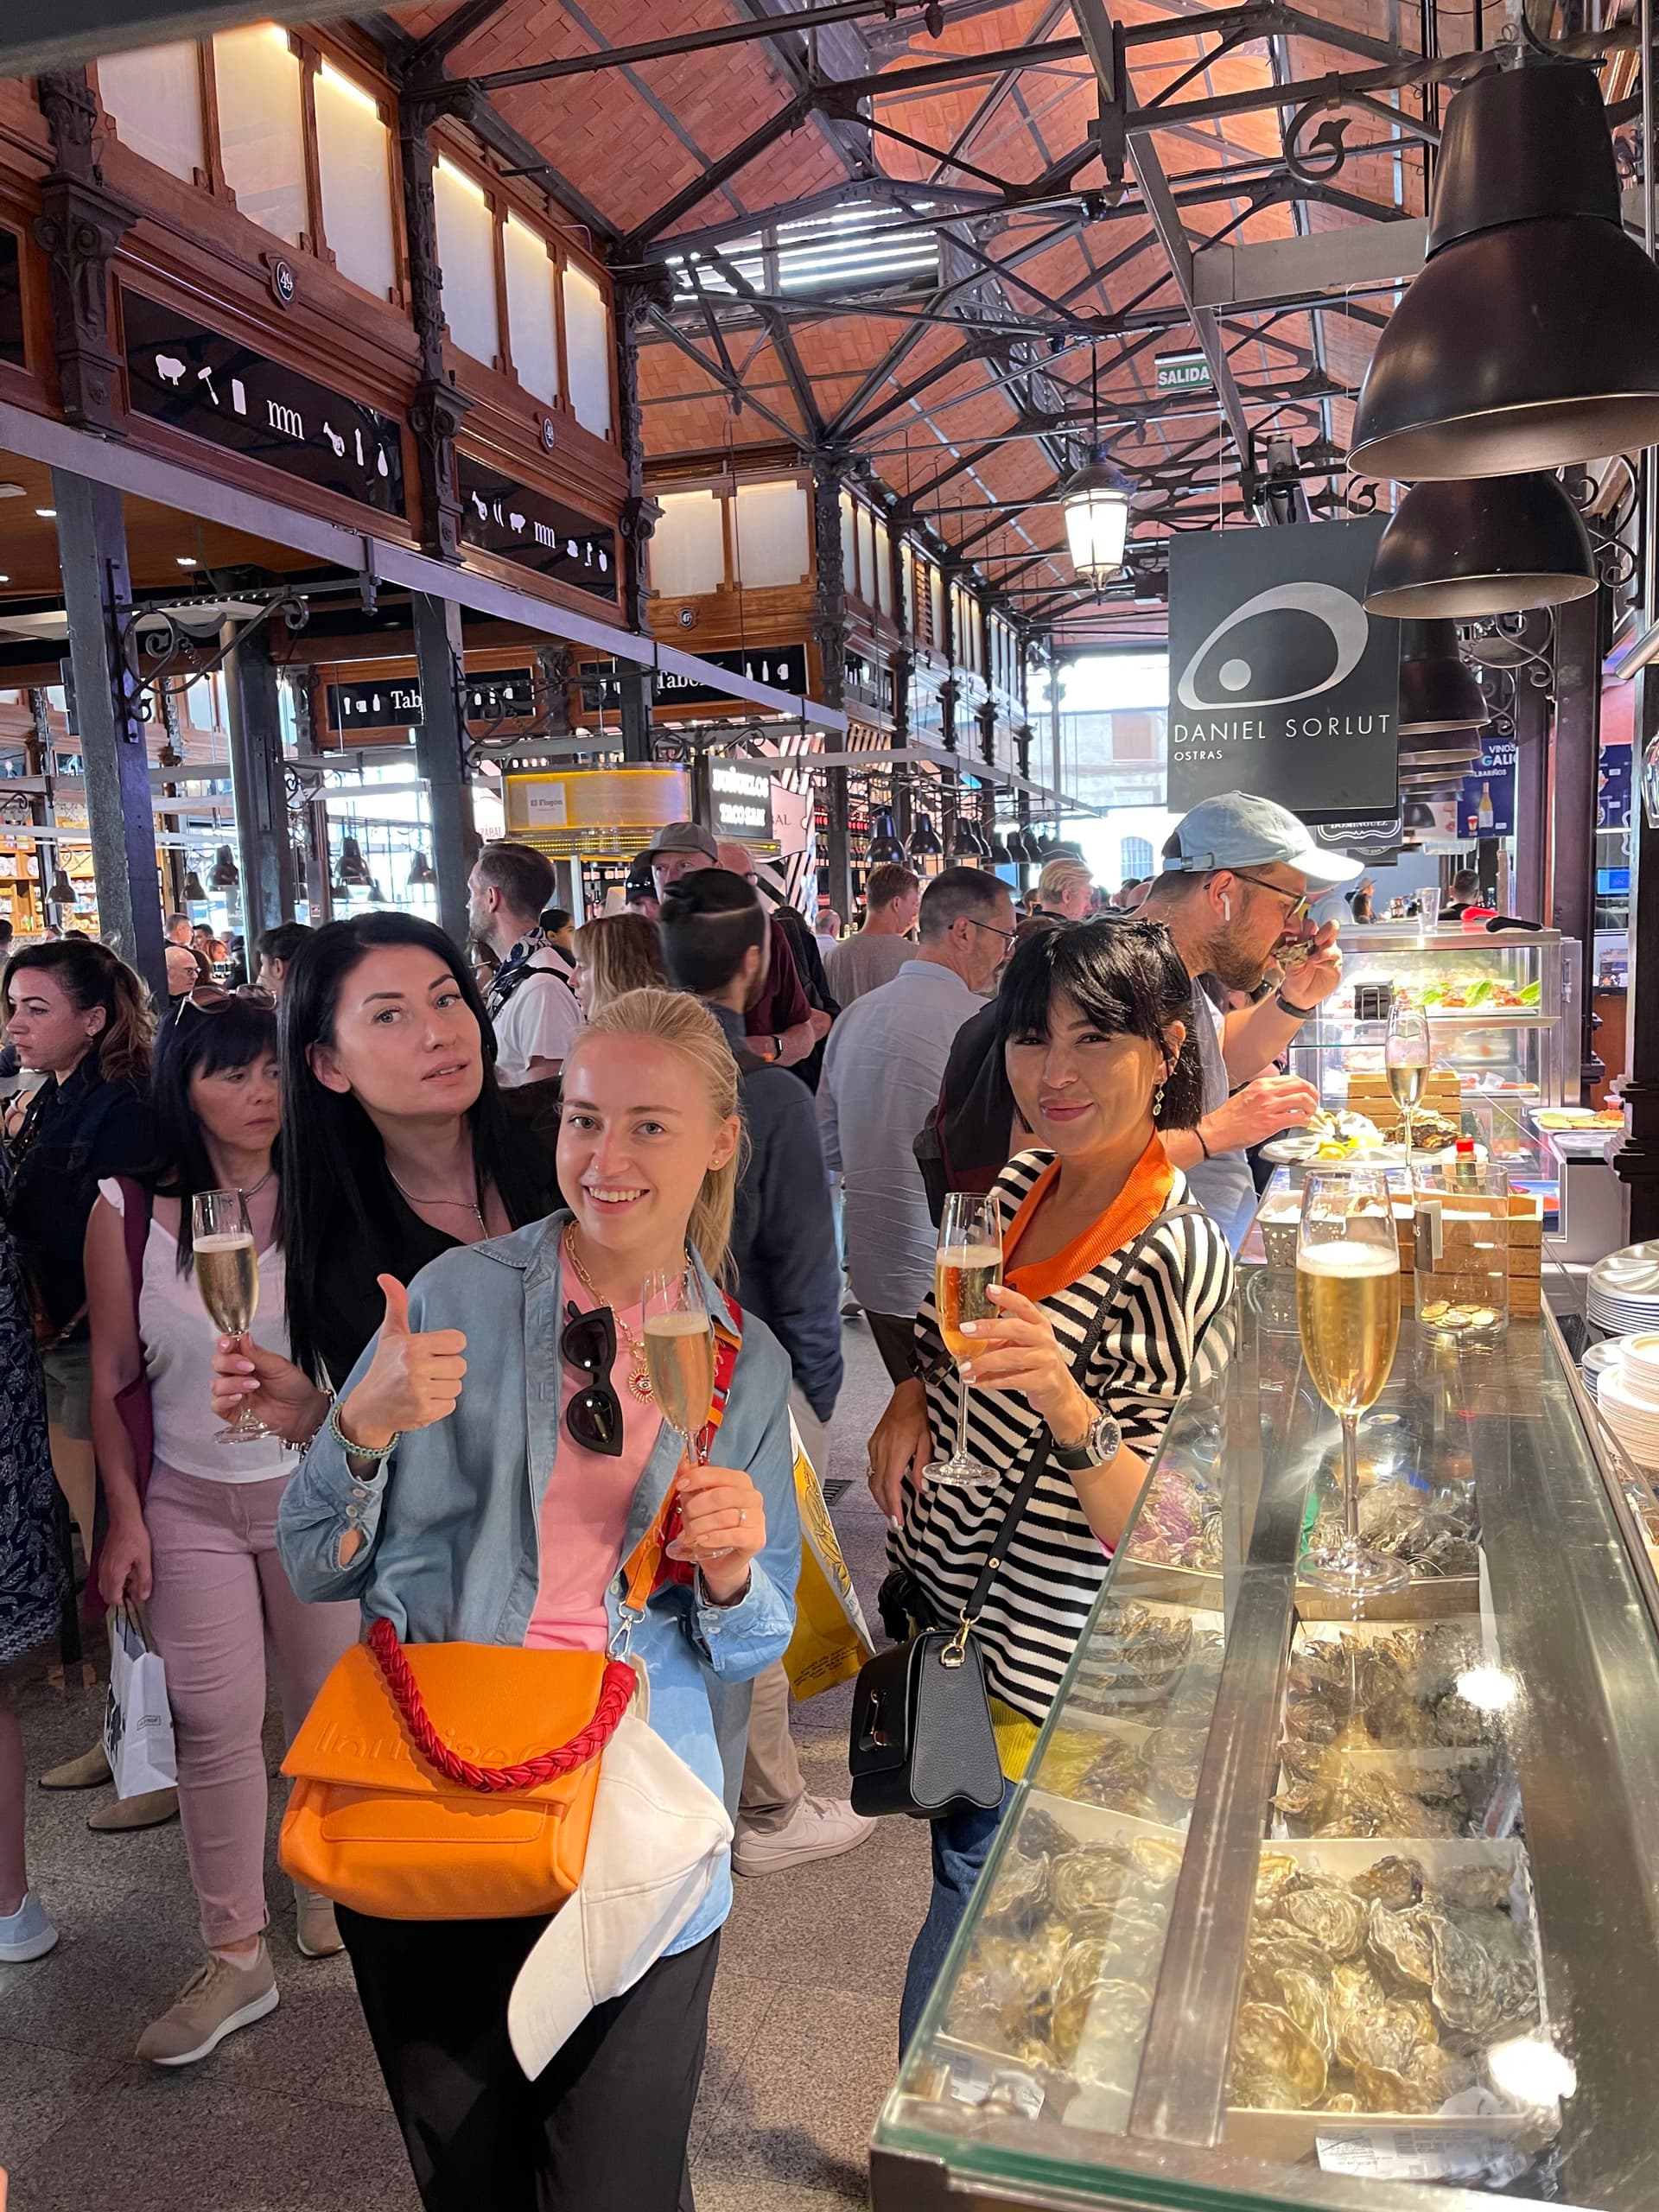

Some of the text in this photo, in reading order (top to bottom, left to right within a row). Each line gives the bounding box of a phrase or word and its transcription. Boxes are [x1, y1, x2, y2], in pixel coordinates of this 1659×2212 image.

[1158, 365, 1210, 385] SALIDA
[1173, 714, 1390, 743] DANIEL SORLUT
[1173, 749, 1224, 761] OSTRAS
[1488, 743, 1515, 753] VINOS
